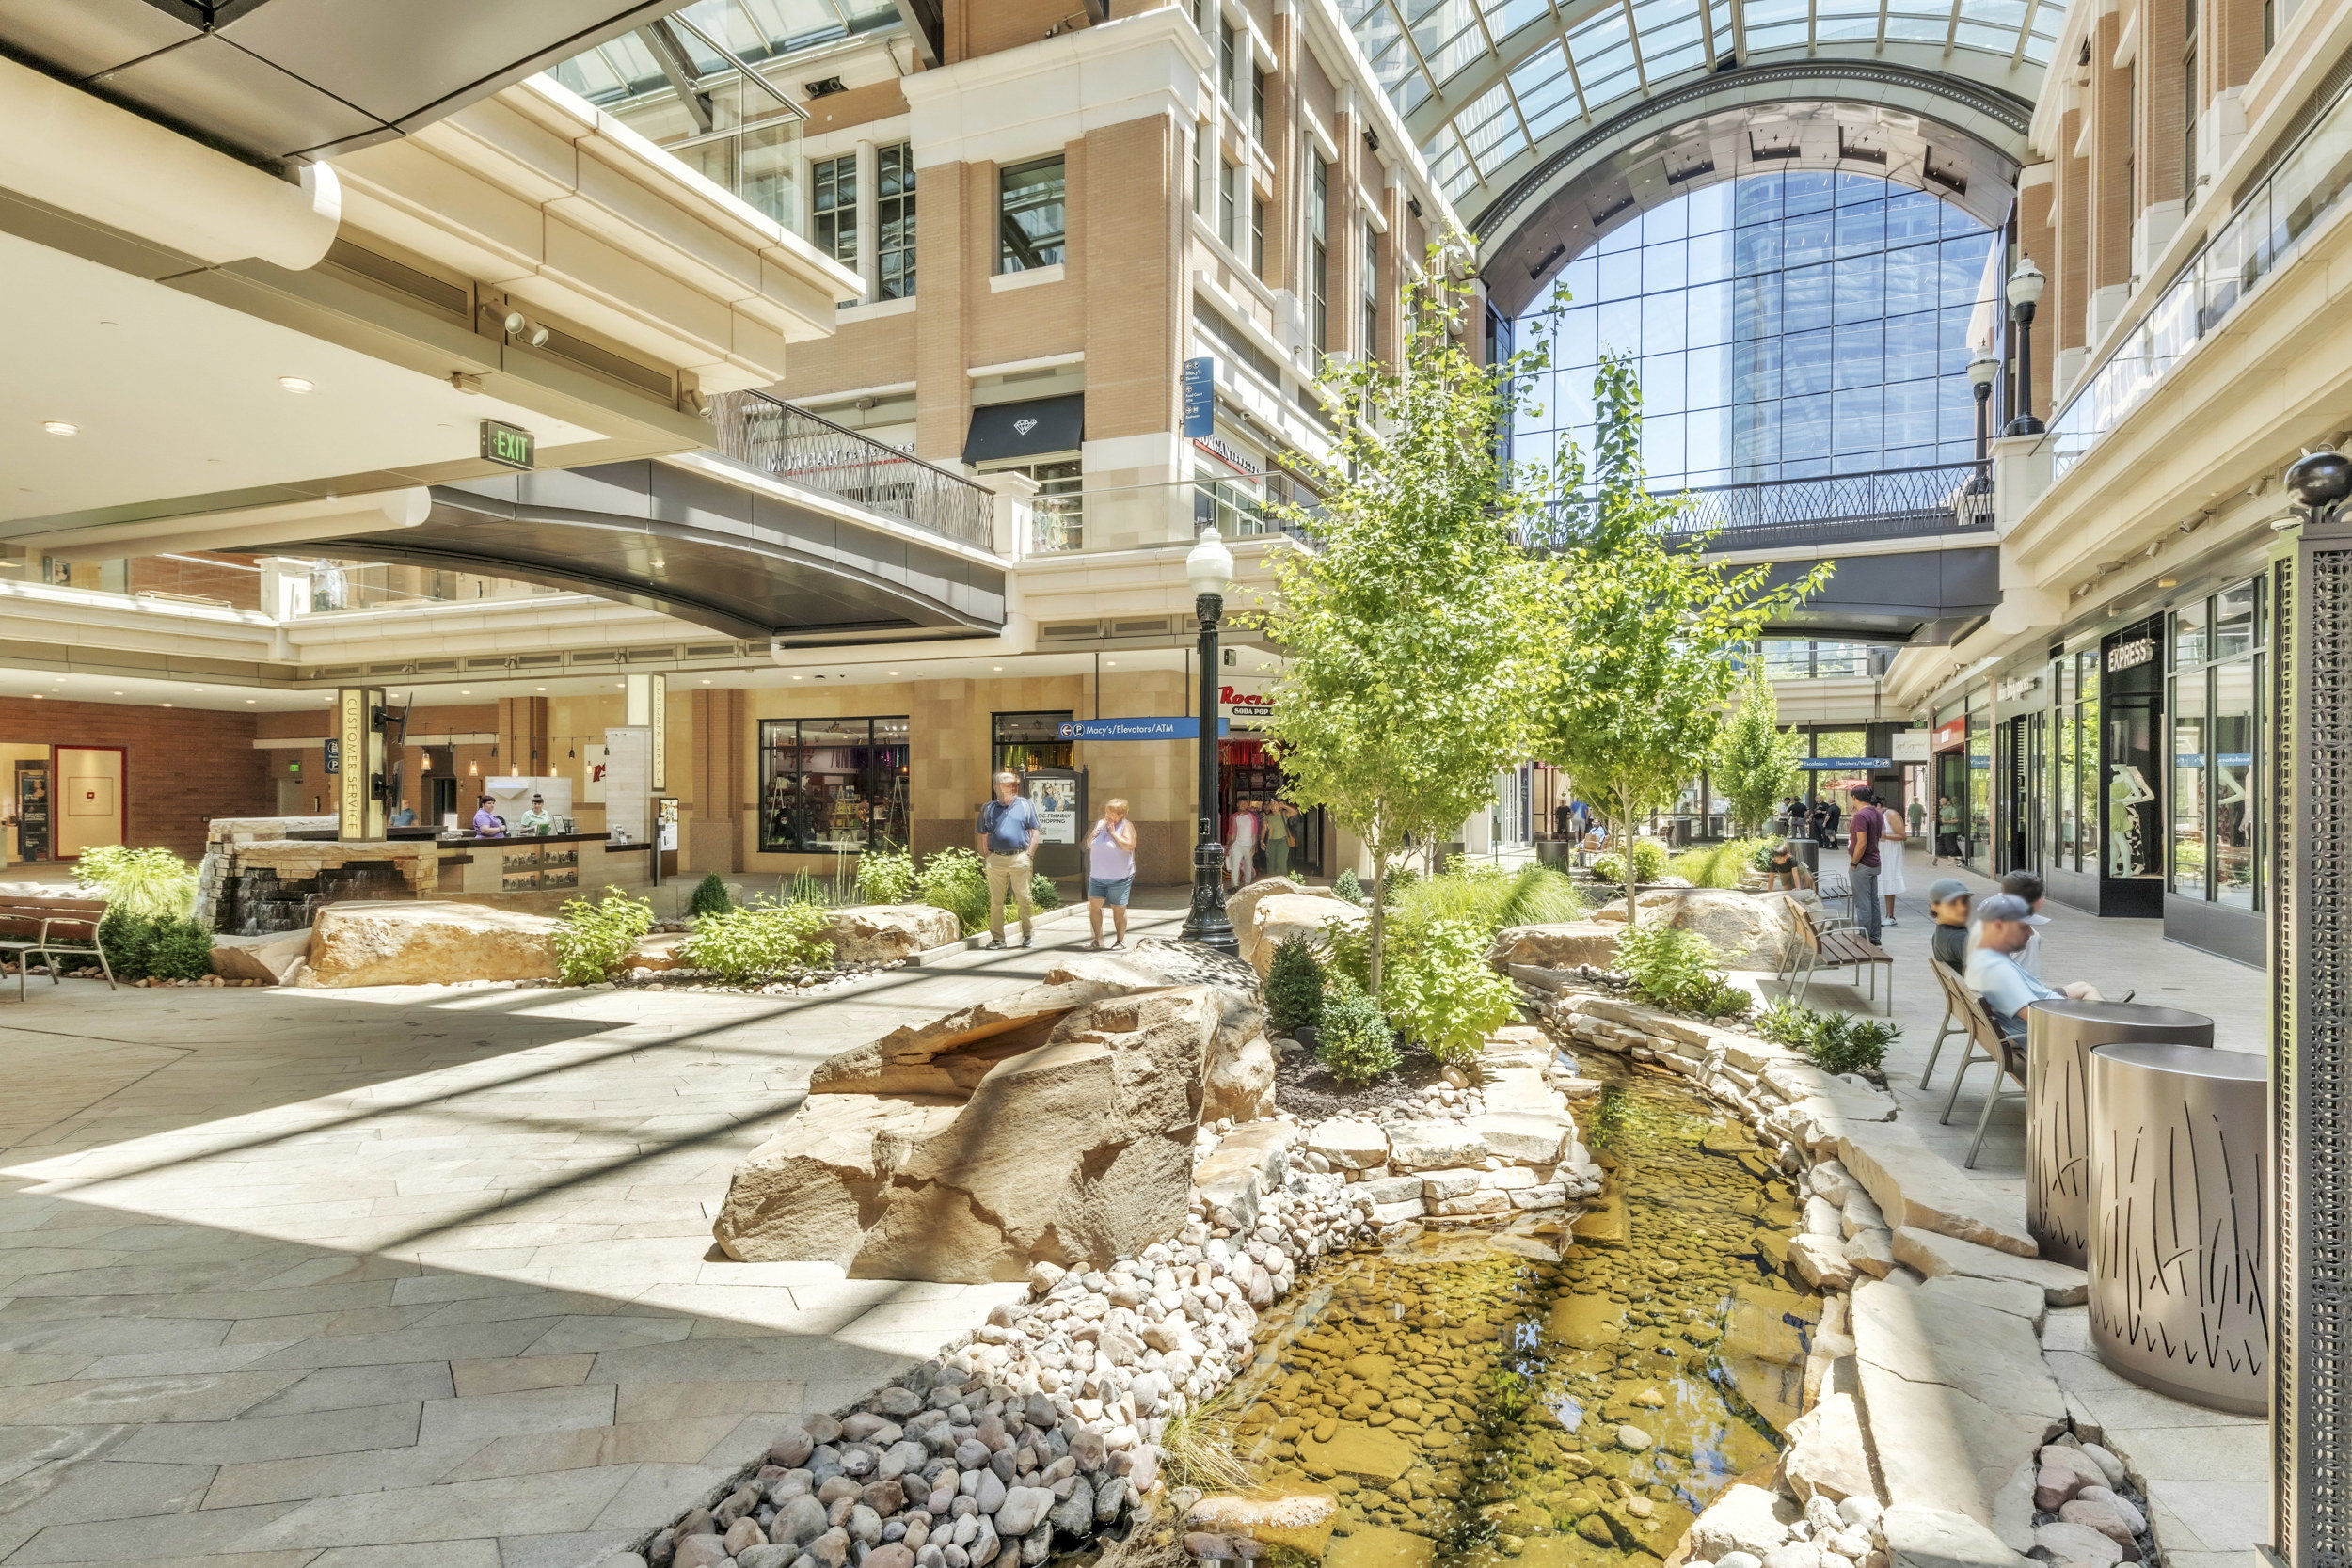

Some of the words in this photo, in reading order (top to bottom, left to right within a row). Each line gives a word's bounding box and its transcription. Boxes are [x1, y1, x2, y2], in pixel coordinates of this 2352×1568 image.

[497, 430, 528, 463] EXIT
[2107, 638, 2149, 673] EXPRESS
[346, 698, 358, 770] CUSTOMER
[1086, 723, 1174, 736] Macy's/Elevators/ATM
[347, 777, 358, 830] SERVICE
